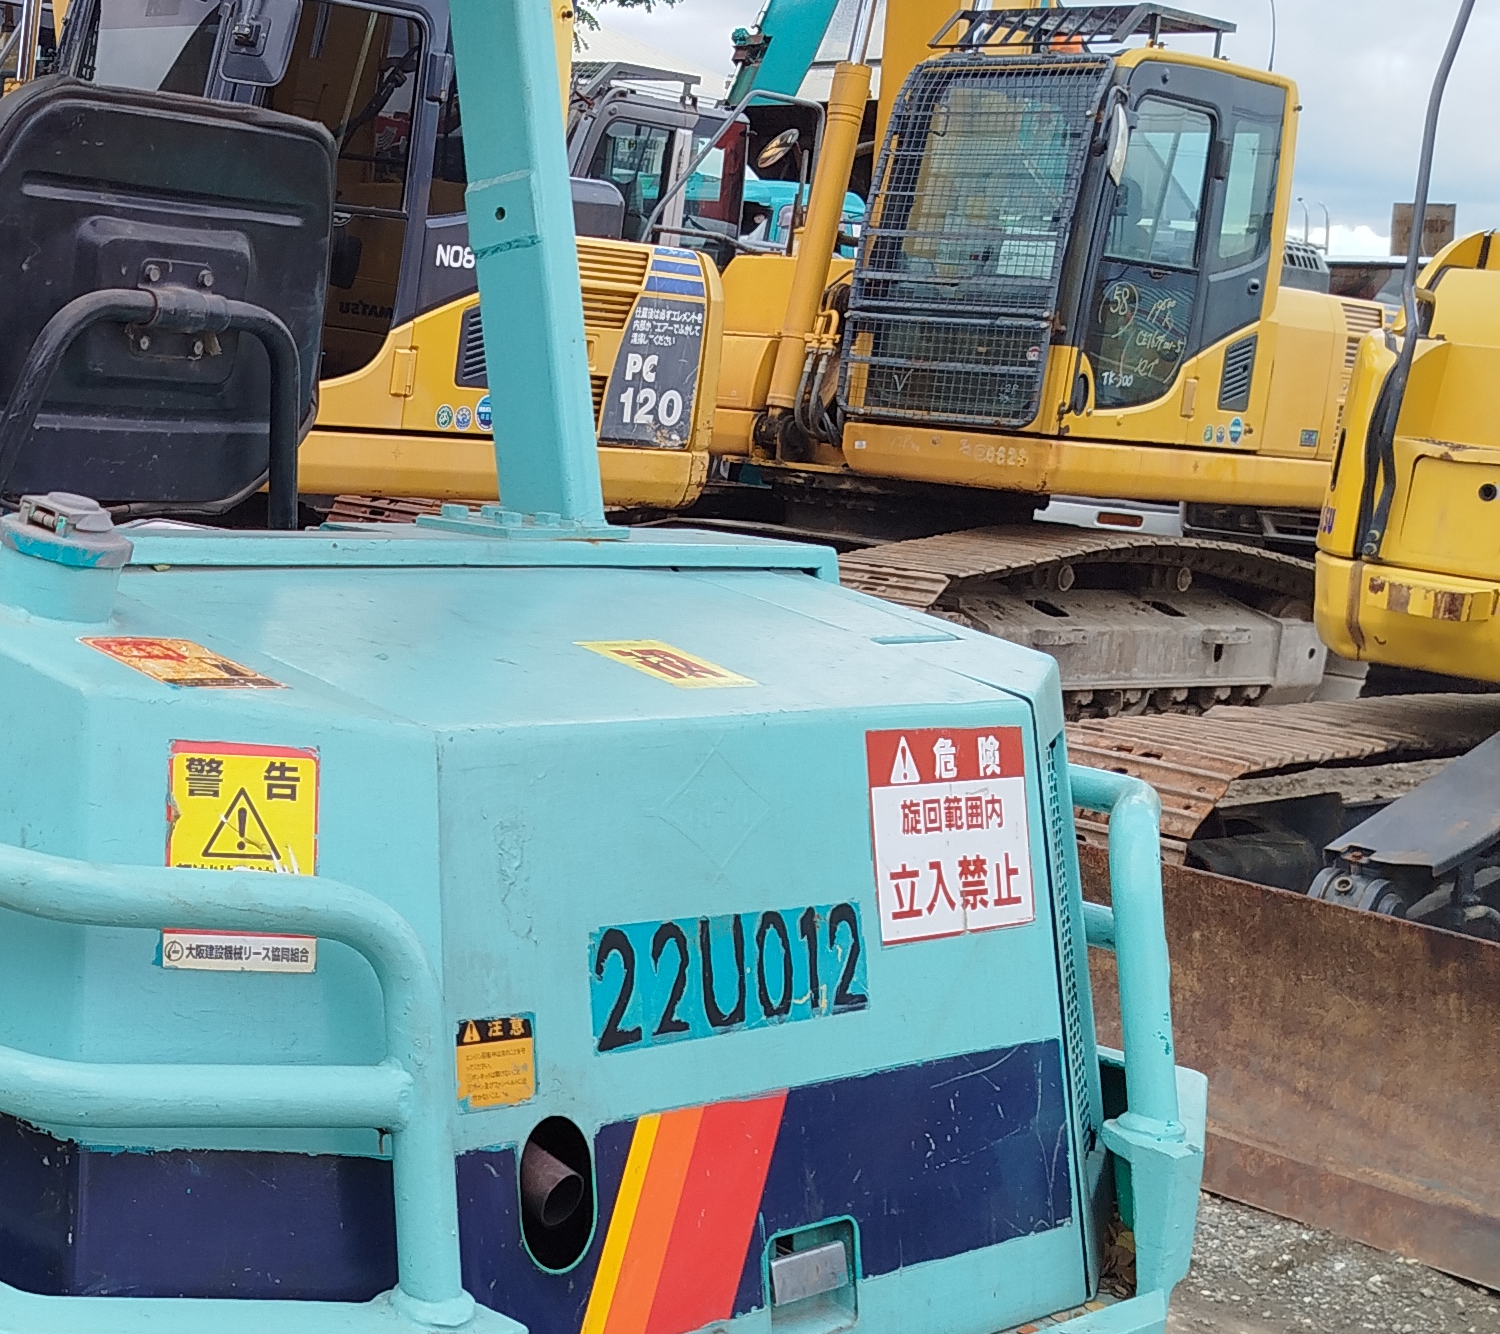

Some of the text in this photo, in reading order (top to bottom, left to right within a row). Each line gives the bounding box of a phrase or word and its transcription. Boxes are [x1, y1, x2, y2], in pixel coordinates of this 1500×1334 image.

[625, 353, 658, 383] PC
[620, 387, 683, 427] 120
[933, 735, 1001, 779] 危険
[185, 757, 301, 801] 警告
[900, 793, 1004, 835] 旋回範囲内
[889, 852, 1023, 921] 立入禁止
[185, 942, 310, 964] 大阪建設機械リース協同組合
[595, 903, 869, 1053] 22U012
[487, 1017, 525, 1038] 注意
